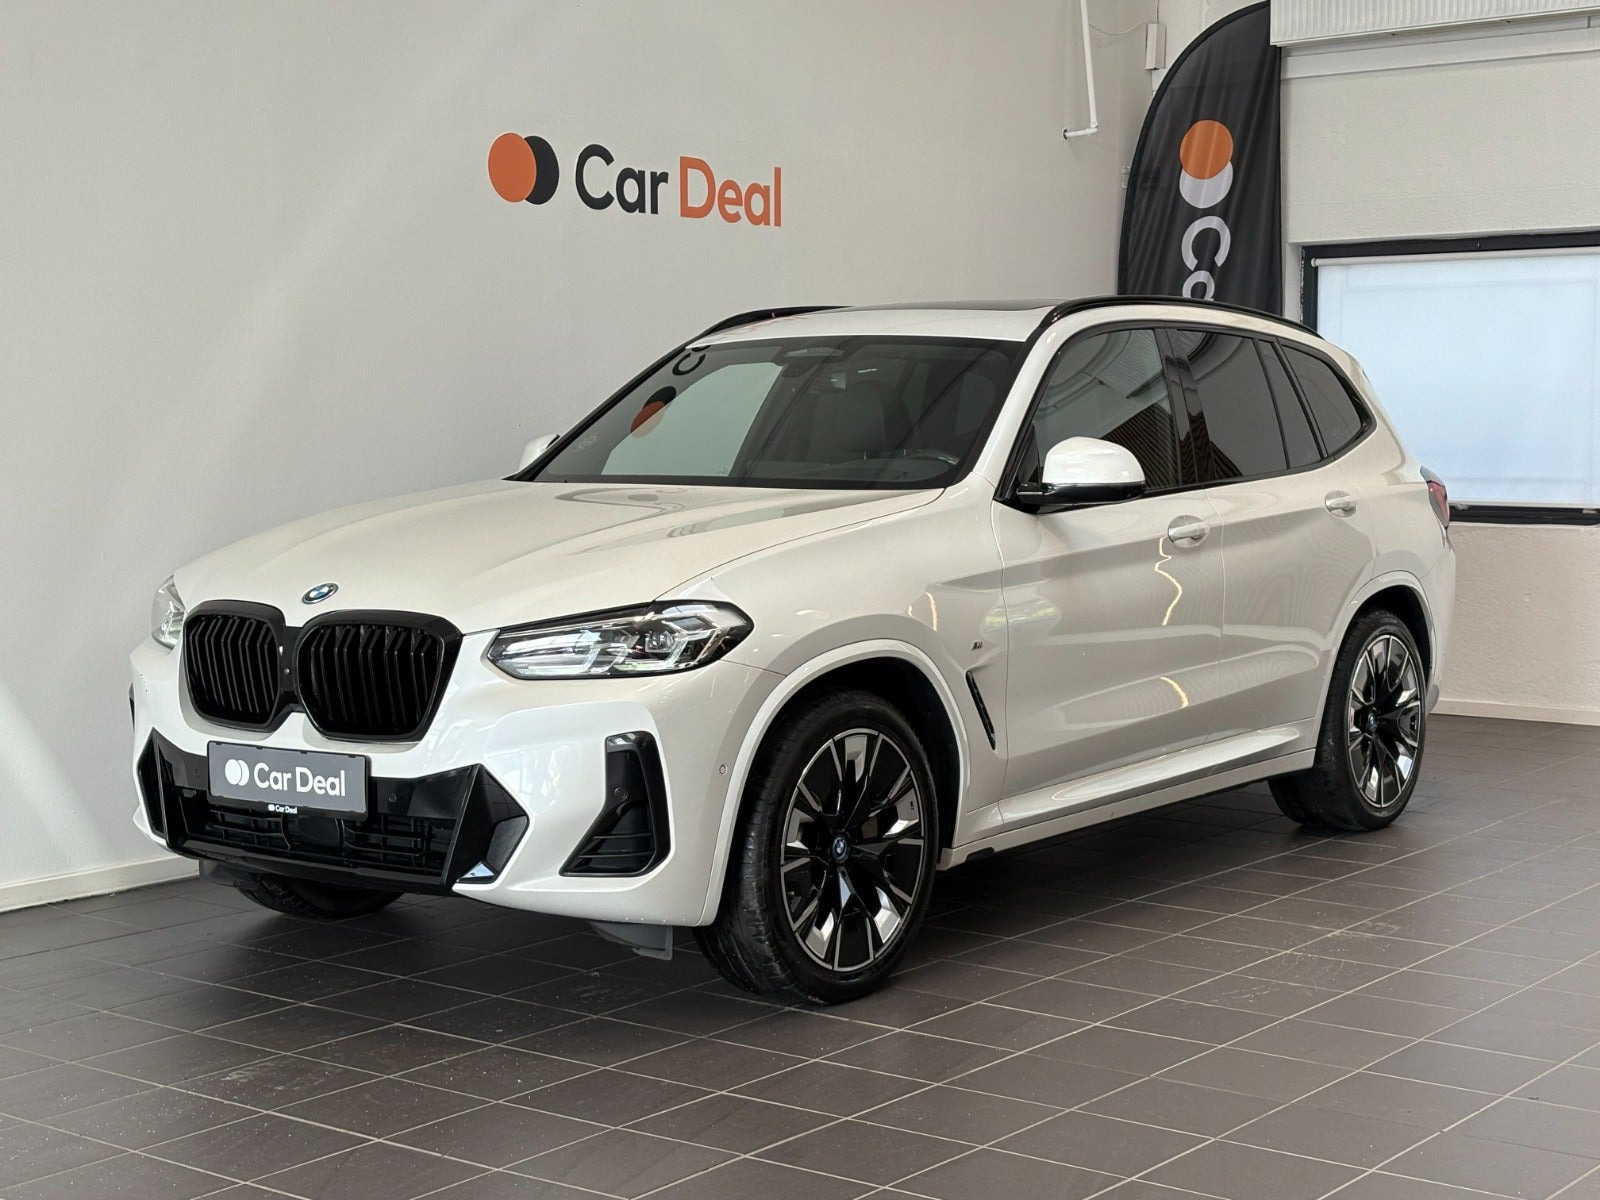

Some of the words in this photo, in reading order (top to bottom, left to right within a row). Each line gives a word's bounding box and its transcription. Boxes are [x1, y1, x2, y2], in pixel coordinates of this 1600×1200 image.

[575, 143, 669, 215] Car
[679, 155, 782, 227] Deal
[253, 762, 292, 791] Car
[295, 766, 346, 797] Deal
[275, 804, 285, 813] Car
[285, 805, 298, 814] Deal
